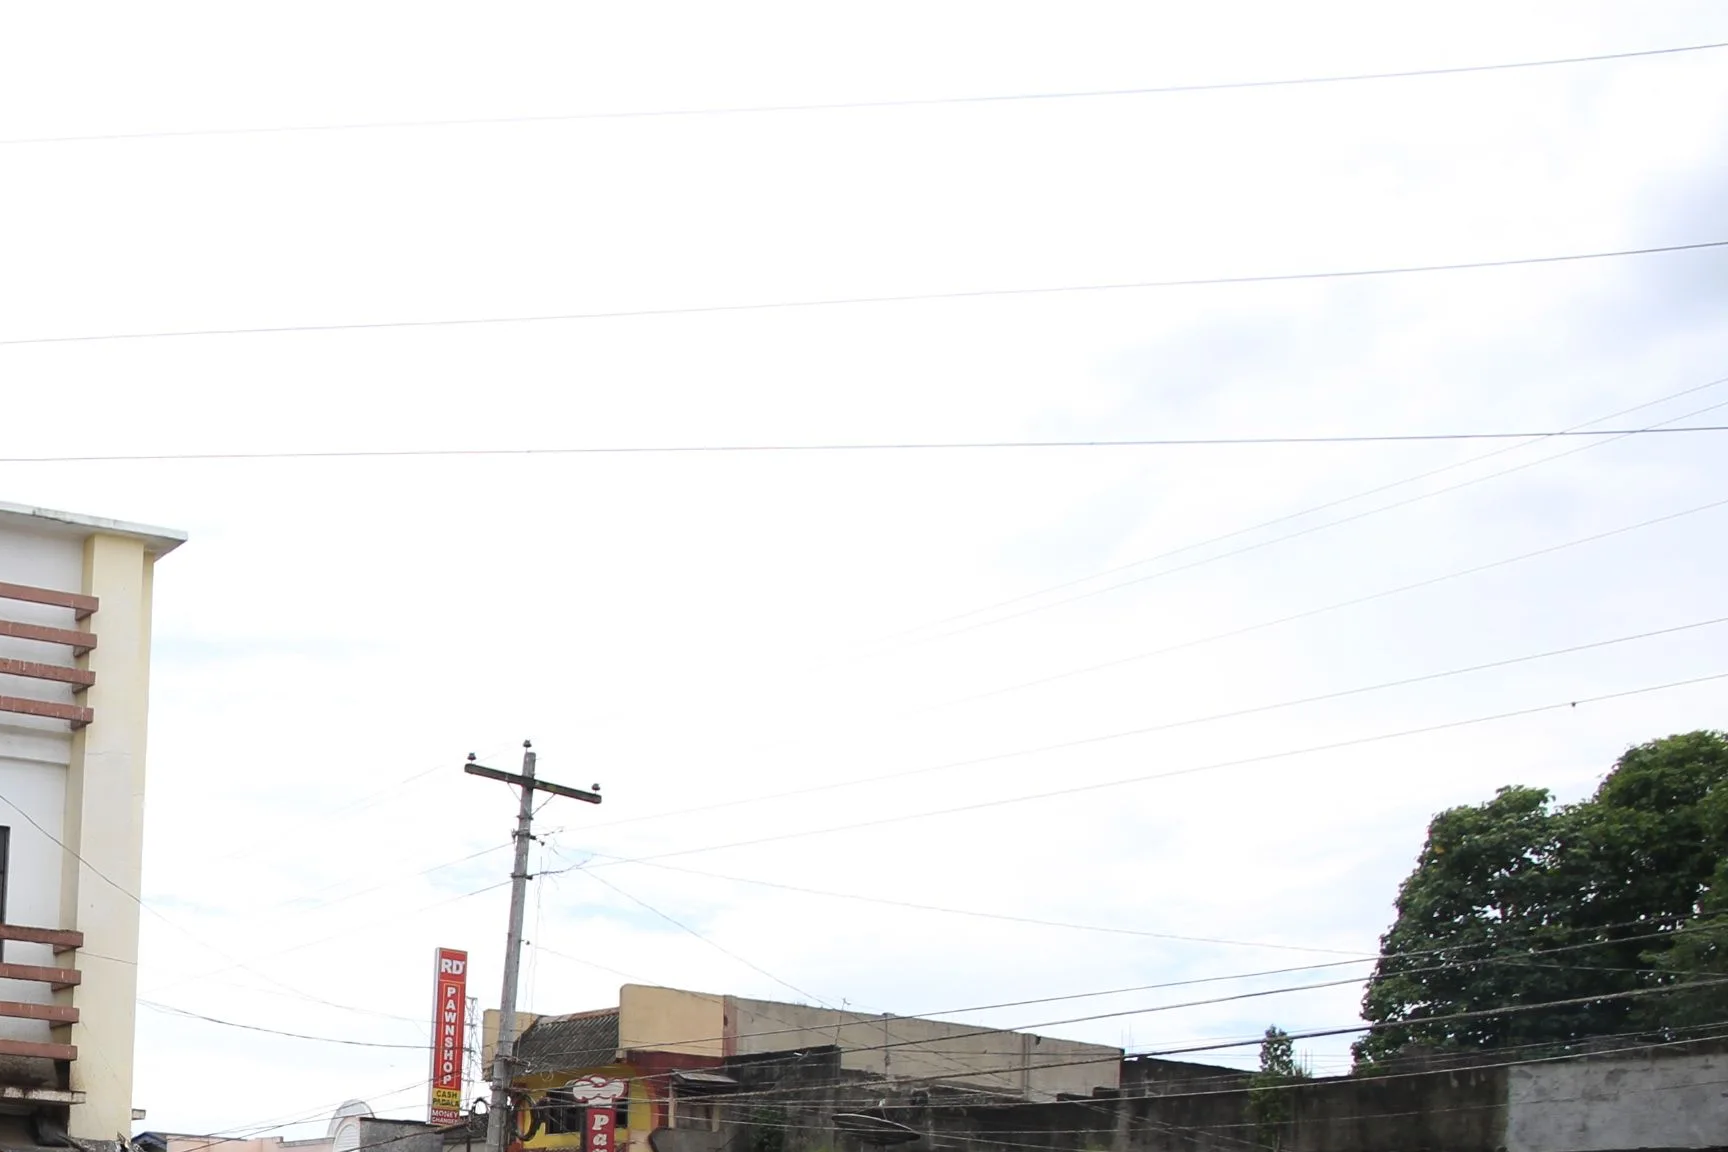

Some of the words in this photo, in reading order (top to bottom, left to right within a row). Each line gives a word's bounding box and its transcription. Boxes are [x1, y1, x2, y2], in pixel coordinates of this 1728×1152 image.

[441, 958, 465, 974] RD
[443, 987, 457, 1085] PAWNSHOP
[436, 1090, 458, 1099] CASH
[432, 1109, 459, 1118] MONEY
